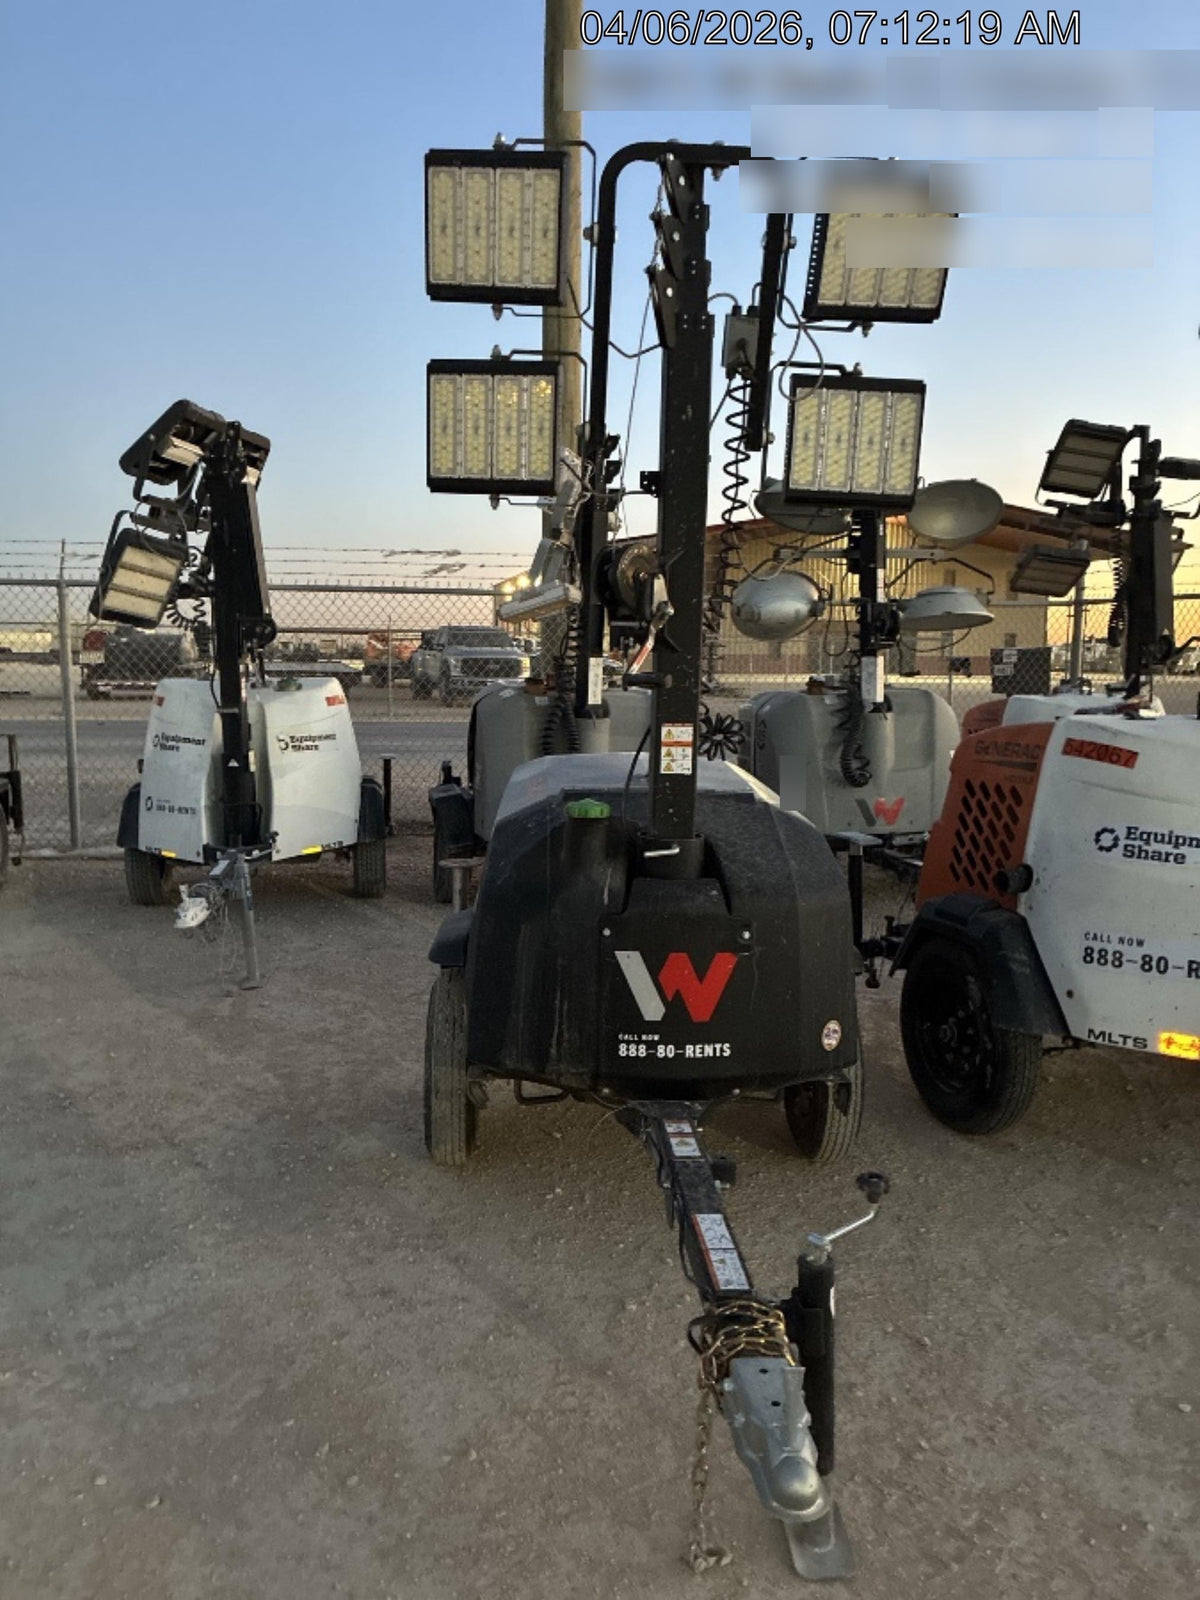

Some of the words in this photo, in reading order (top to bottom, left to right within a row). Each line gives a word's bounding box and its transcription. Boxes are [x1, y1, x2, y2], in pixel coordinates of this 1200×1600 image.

[1122, 843, 1187, 865] Share
[1084, 932, 1113, 944] CALL
[1117, 936, 1146, 947] NOW
[618, 1033, 639, 1041] CALL
[1087, 1028, 1148, 1049] MLTS
[618, 1042, 731, 1058] 888-80-RENTS
